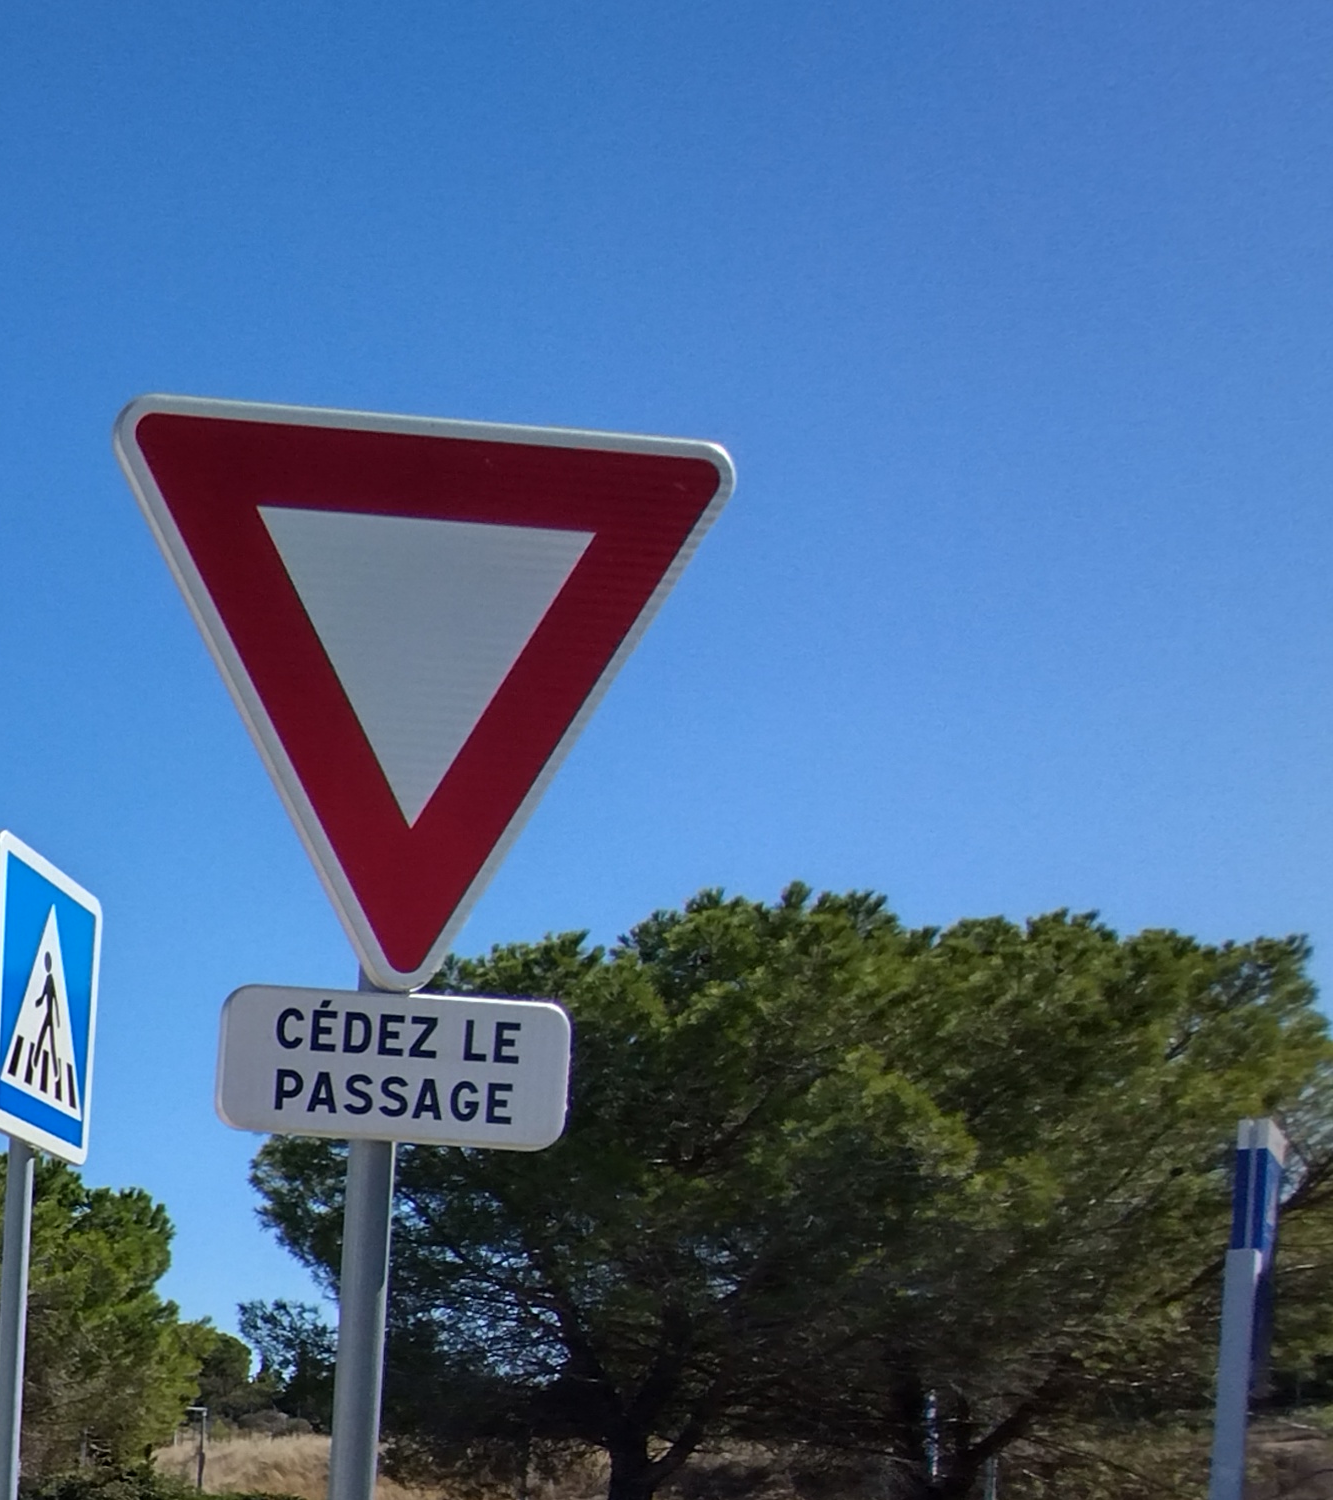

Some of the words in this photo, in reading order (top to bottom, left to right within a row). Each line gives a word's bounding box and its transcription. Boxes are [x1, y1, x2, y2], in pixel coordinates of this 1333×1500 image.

[276, 1000, 439, 1060] CÉDEZ
[462, 1019, 522, 1065] LE
[273, 1068, 514, 1125] PASSAGE
